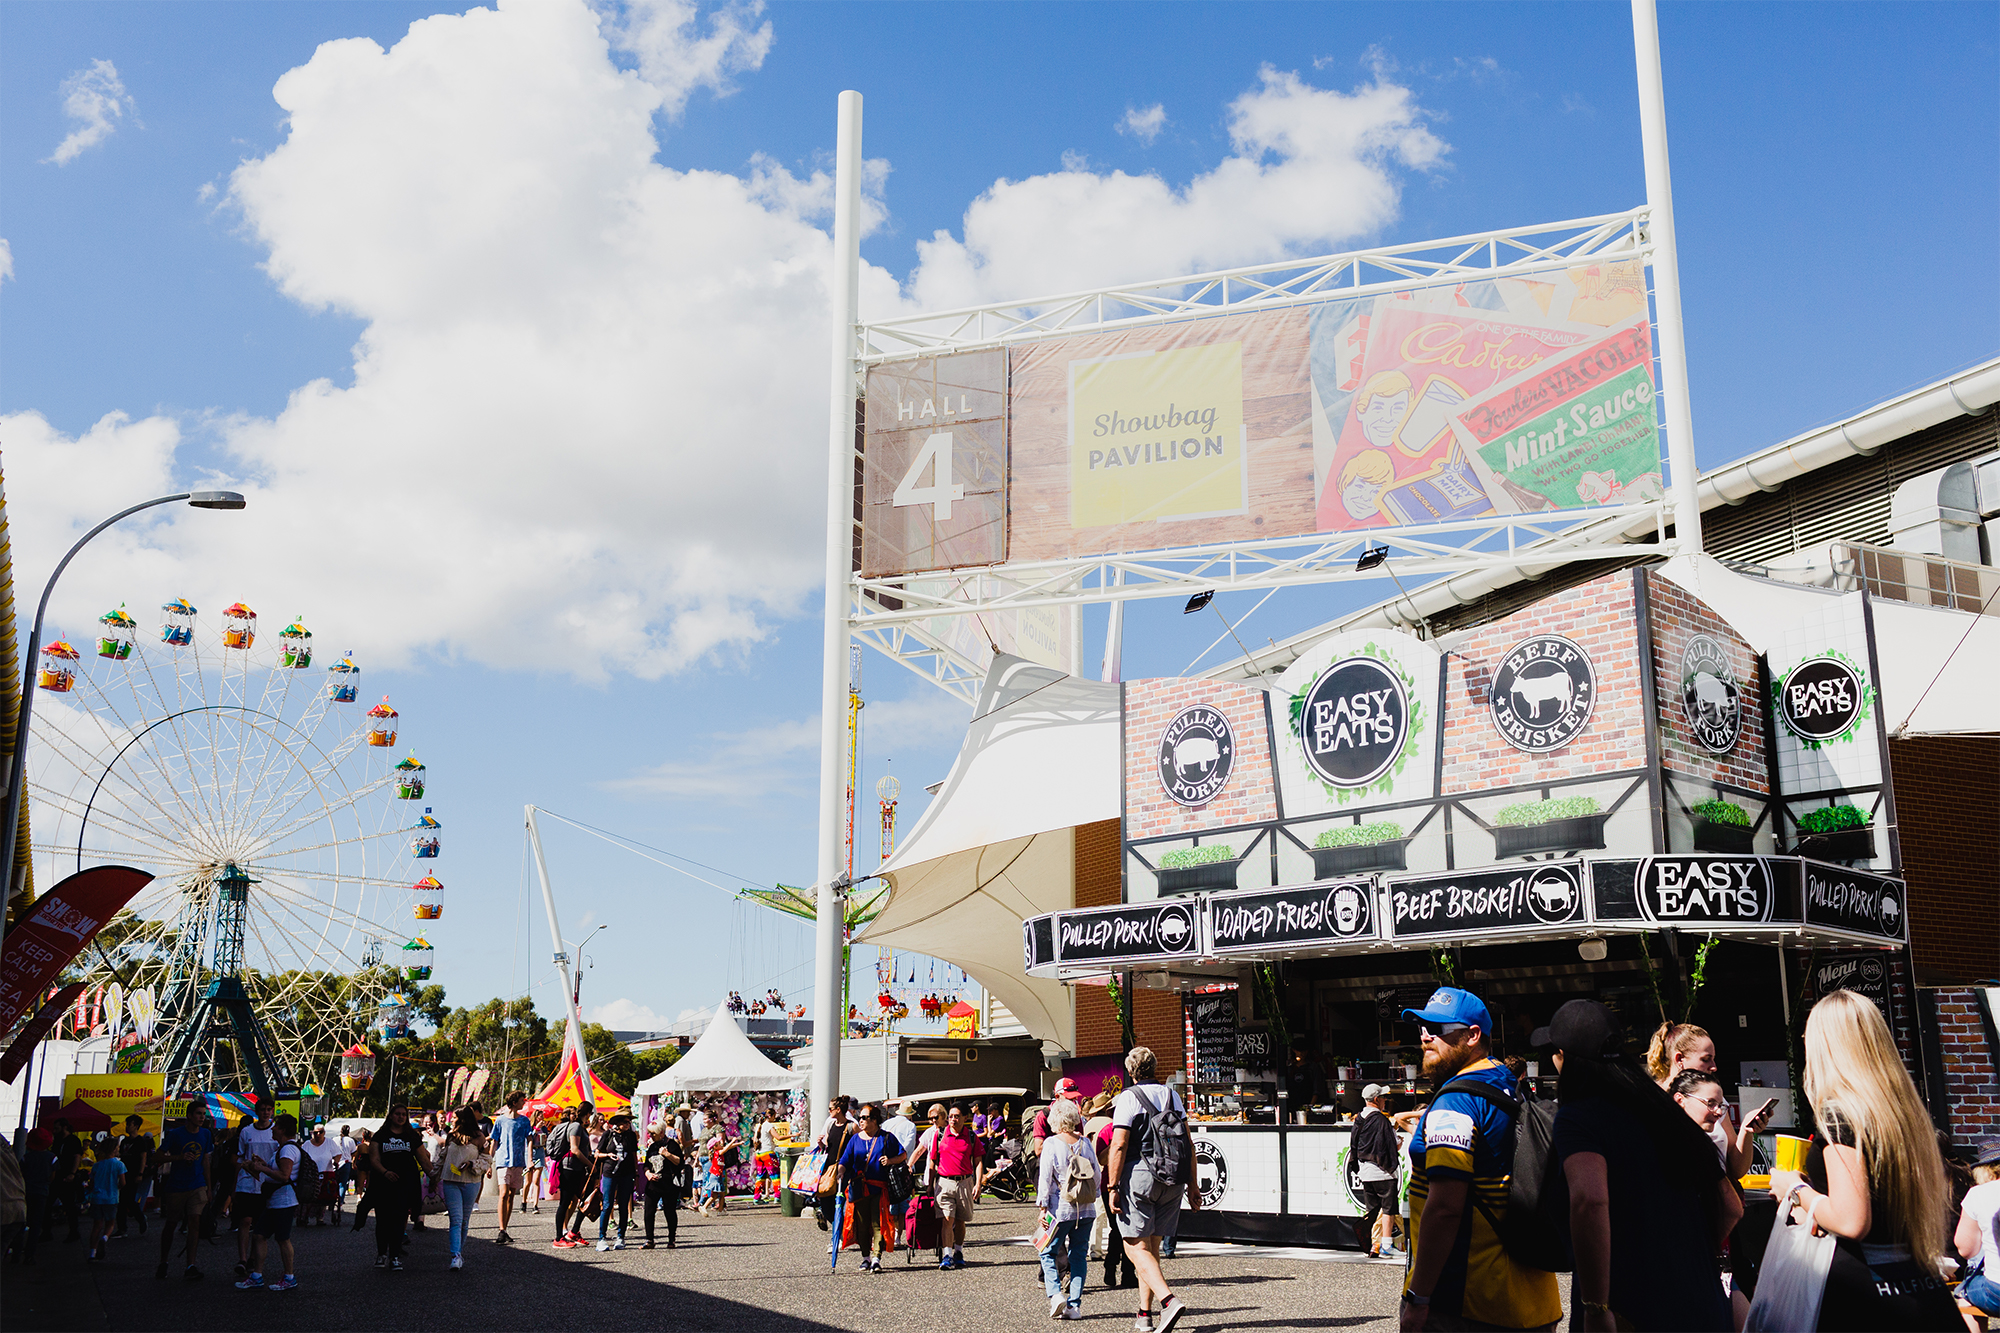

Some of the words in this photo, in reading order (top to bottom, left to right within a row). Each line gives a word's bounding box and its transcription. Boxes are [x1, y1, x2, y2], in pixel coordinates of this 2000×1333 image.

[1400, 322, 1544, 370] Cadbur
[1476, 322, 1501, 334] ONE
[1502, 325, 1518, 337] OF
[1519, 328, 1541, 339] THE
[1540, 331, 1578, 344] FAMILY
[1465, 385, 1548, 438] Fowlers
[1542, 333, 1651, 398] VACOLA
[897, 394, 973, 421] HALL
[1092, 402, 1220, 438] Showbag
[1505, 418, 1568, 472] Mint
[1570, 382, 1652, 437] Sauce
[1088, 435, 1225, 470] PAVILION
[1532, 456, 1560, 477] With
[1559, 438, 1598, 464] LAMB!
[1598, 430, 1615, 445] Oh
[1614, 413, 1646, 437] MAN!
[1540, 473, 1558, 487] WE
[1559, 463, 1581, 478] TWO
[1584, 453, 1599, 465] GO
[1601, 427, 1651, 456] TOGETHER
[892, 431, 965, 521] 4
[1437, 479, 1463, 500] MILK
[1445, 474, 1475, 497] DAIRY
[1408, 485, 1442, 518] CHOCOLATE
[1506, 642, 1579, 674] BEEF
[1685, 642, 1736, 686] PULLED
[1789, 676, 1849, 703] EASY
[1314, 688, 1393, 728] EASY
[1497, 693, 1588, 747] BRISKET
[1792, 693, 1852, 719] EATS
[1166, 711, 1227, 747] PULLED
[1315, 714, 1395, 755] EATS
[1697, 717, 1736, 747] PORK
[1172, 771, 1223, 800] PORK
[1655, 862, 1756, 890] EASY
[1393, 889, 1443, 925] BEEF
[1446, 877, 1525, 919] BRISKET!
[1656, 888, 1759, 916] EATS
[1808, 874, 1848, 914] PULLED
[1848, 882, 1880, 921] PORK!
[1061, 918, 1113, 952] PULLED
[1114, 915, 1156, 950] PORK!
[1214, 906, 1273, 942] LOADED
[1276, 899, 1325, 933] FRIES!
[4, 951, 42, 979] CALM
[18, 938, 54, 962] KEEP
[3, 969, 19, 981] AND
[1818, 960, 1857, 984] Menu
[1862, 983, 1882, 992] Food
[1196, 998, 1220, 1017] Menu
[1237, 1034, 1264, 1045] EASY
[1237, 1044, 1265, 1054] EATS
[75, 1088, 114, 1099] Cheese
[115, 1087, 153, 1099] Toastie
[1194, 1142, 1222, 1159] EEF
